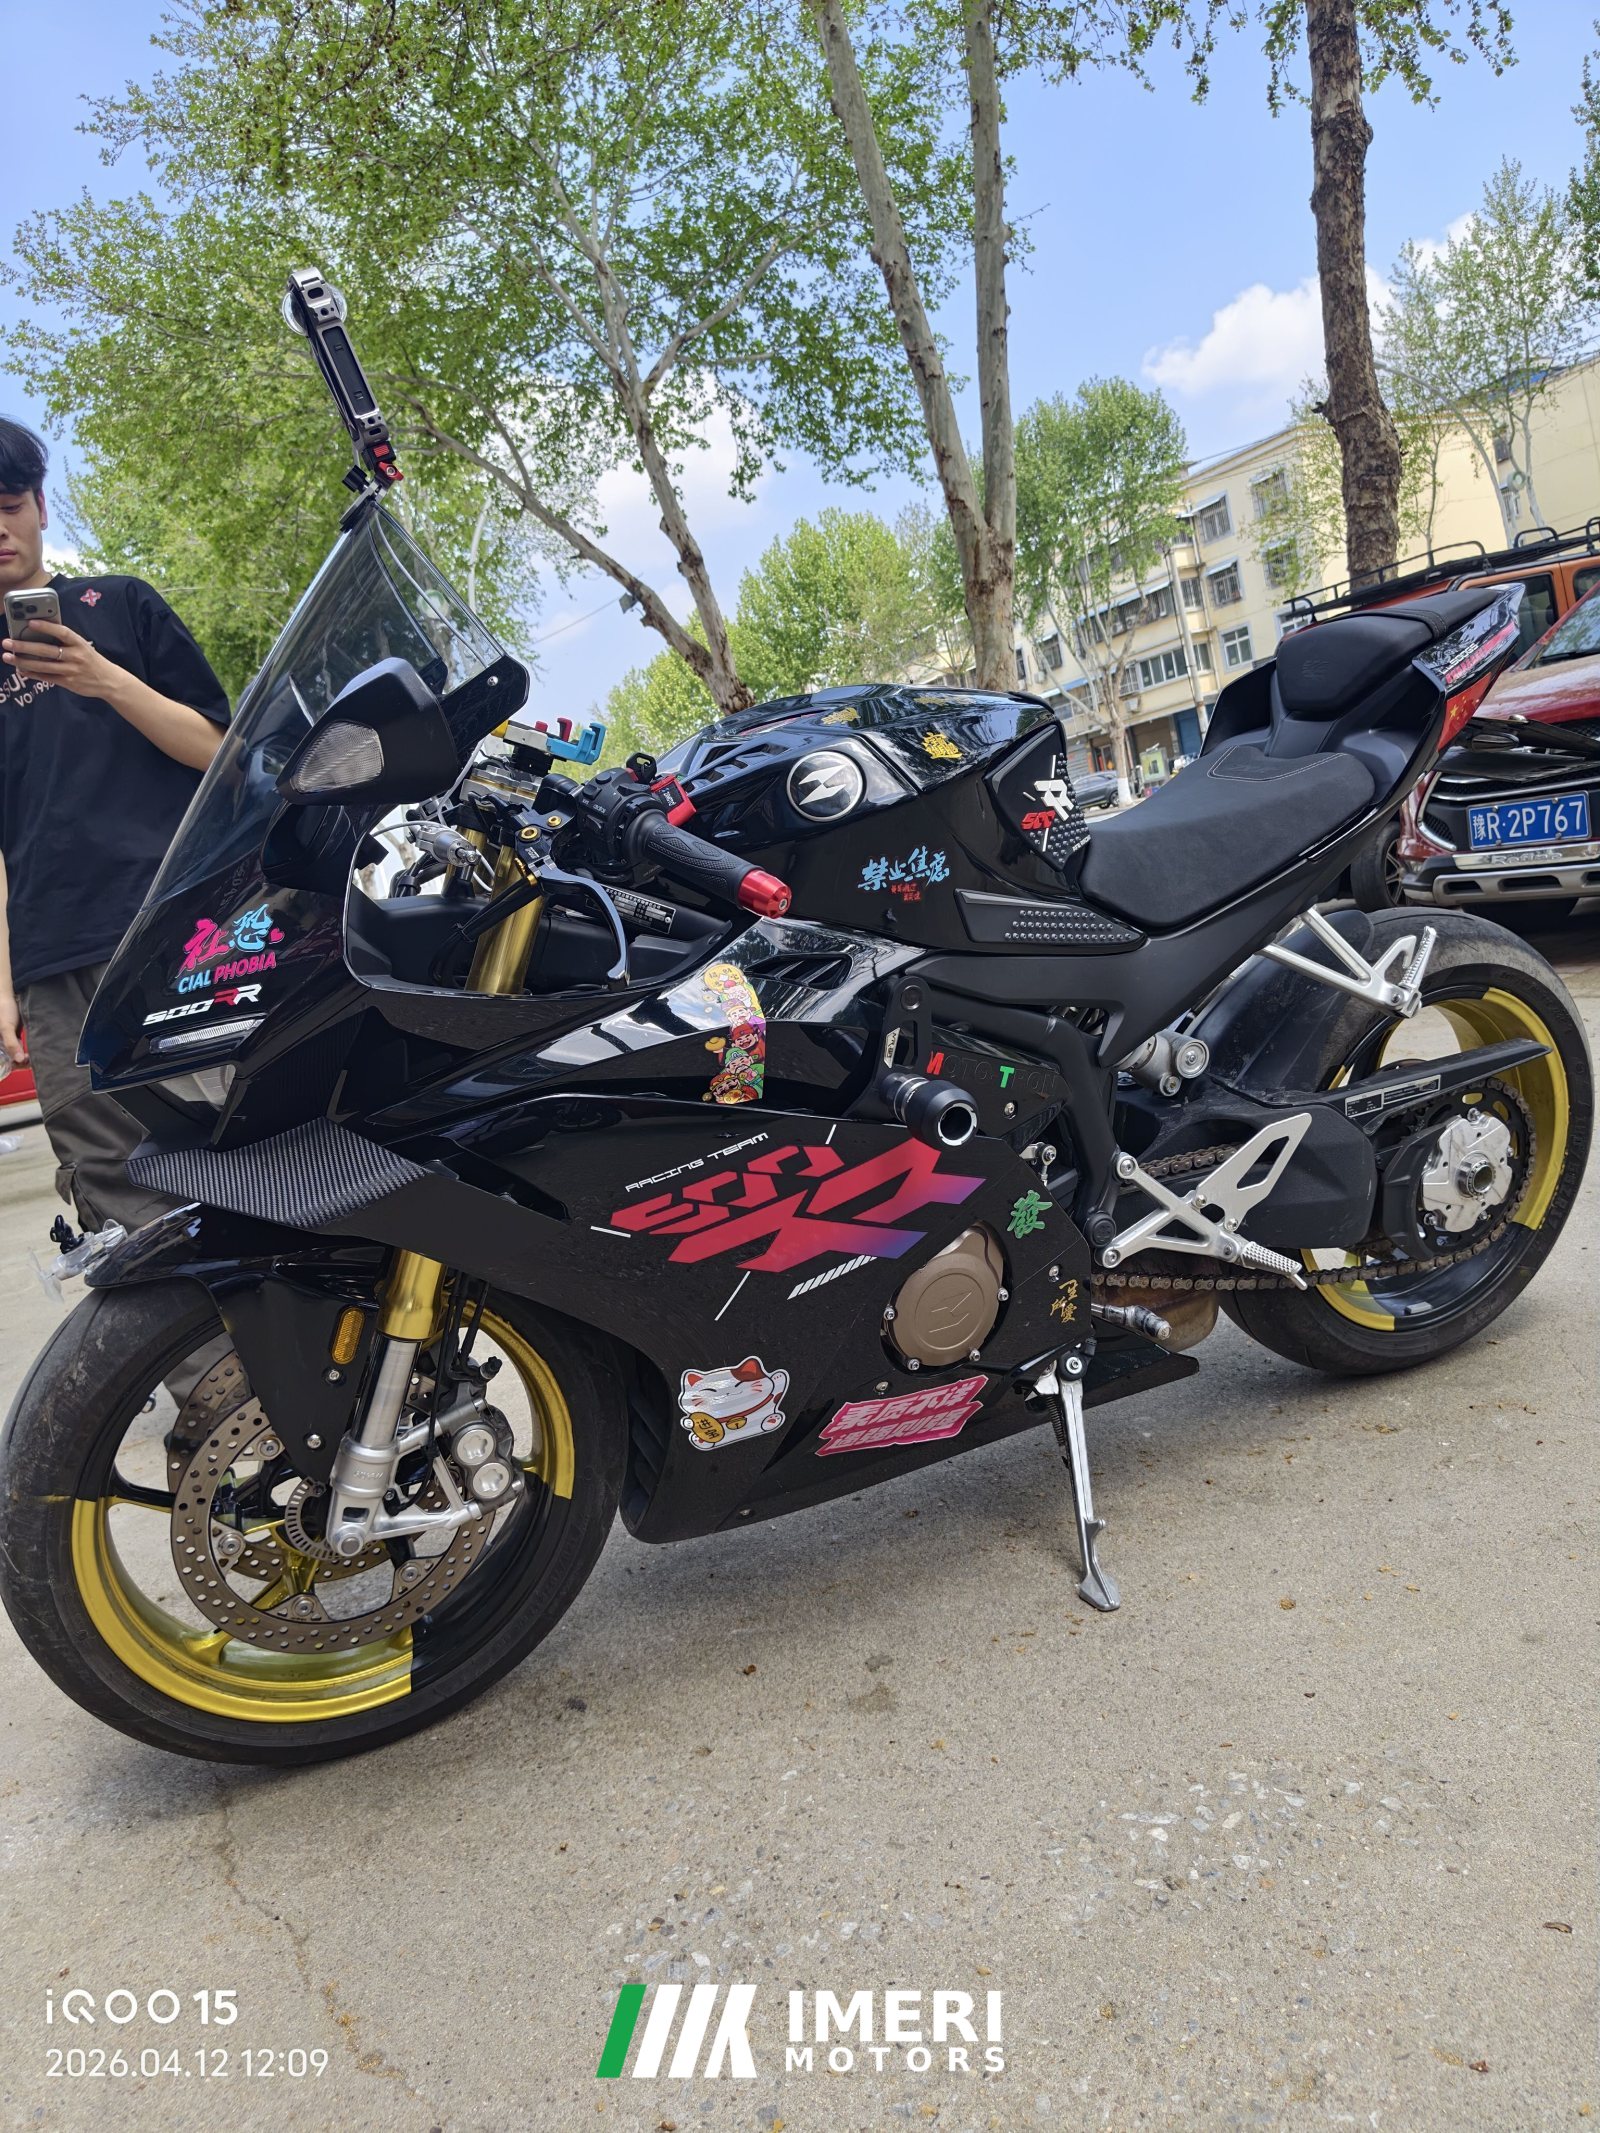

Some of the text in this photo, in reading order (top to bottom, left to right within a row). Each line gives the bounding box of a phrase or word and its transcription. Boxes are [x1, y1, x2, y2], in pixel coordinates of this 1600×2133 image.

[857, 845, 951, 891] 禁止焦虑
[175, 903, 275, 978] 社恐
[177, 951, 278, 994] CIAL PHOBIA
[625, 1132, 769, 1192] RACING TEAM
[1007, 1190, 1053, 1239] 發
